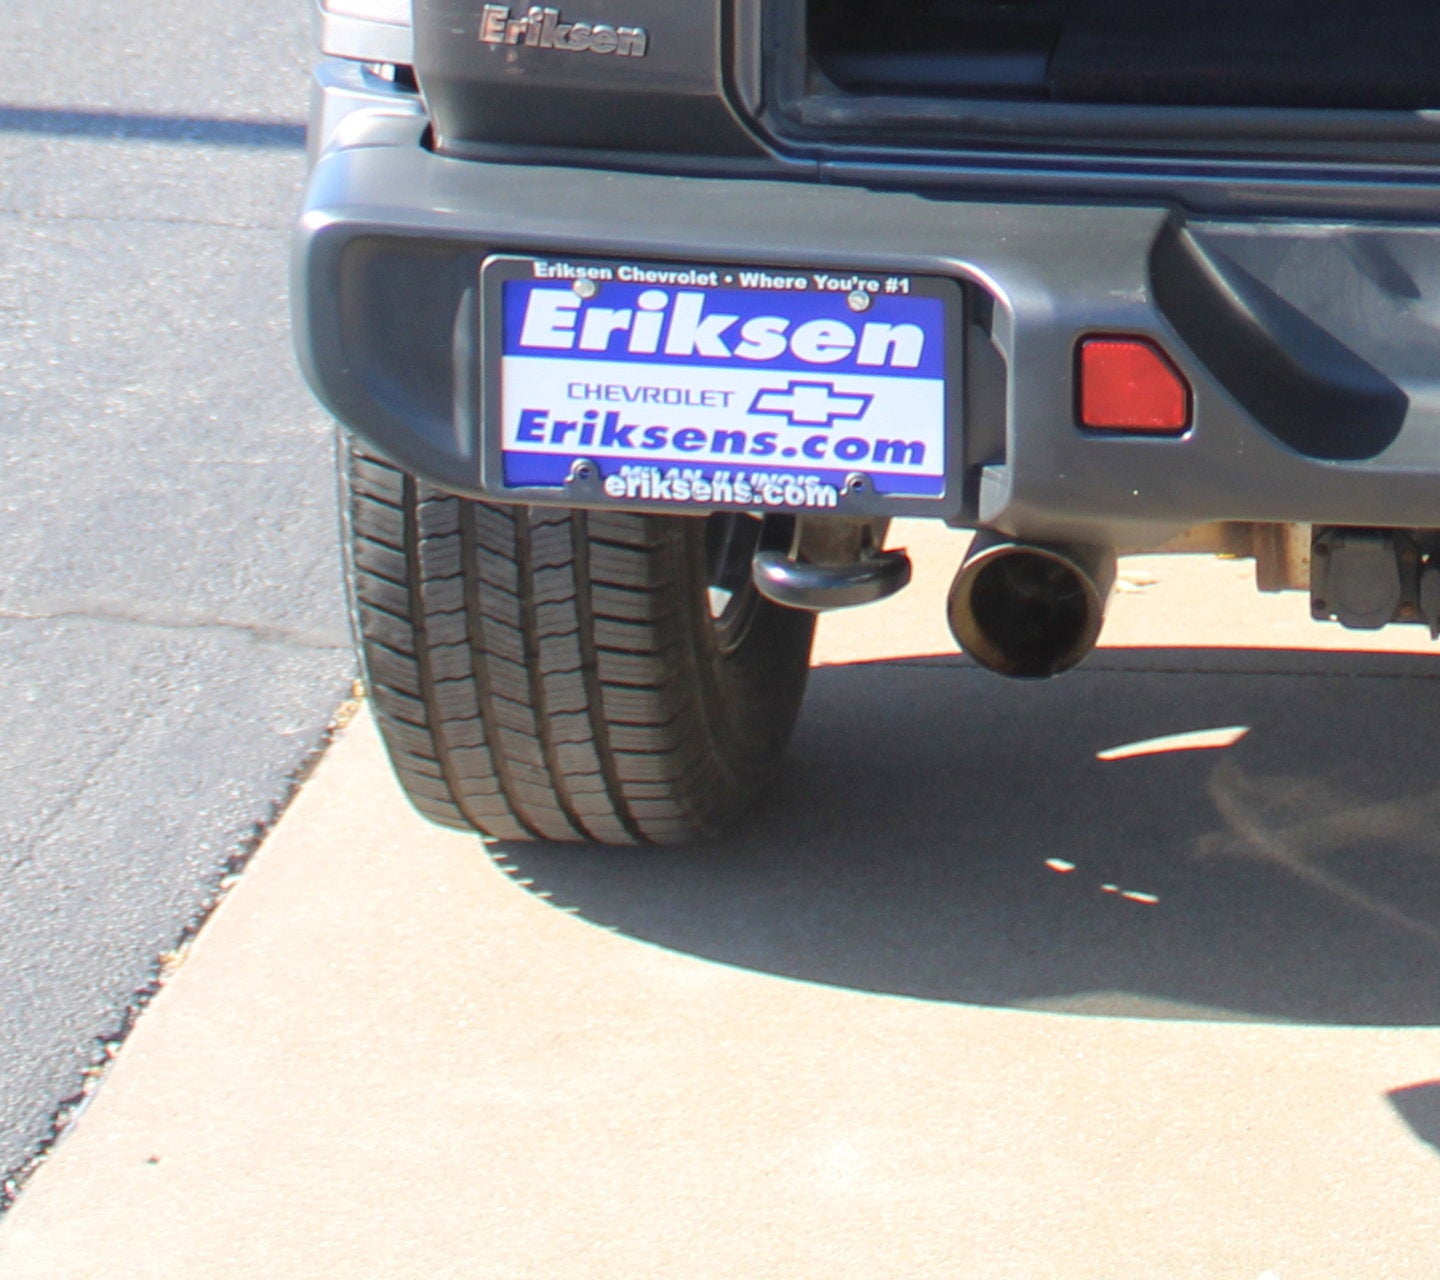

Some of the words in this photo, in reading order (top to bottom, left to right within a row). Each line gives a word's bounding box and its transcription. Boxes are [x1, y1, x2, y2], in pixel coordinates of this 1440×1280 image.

[478, 3, 649, 58] Eriksen
[533, 260, 613, 280] Eriksen
[617, 265, 720, 286] Chevrolet
[738, 272, 808, 290] Where
[813, 274, 880, 292] You're
[885, 277, 910, 294] #1
[518, 287, 926, 369] Eriksen
[566, 381, 735, 409] CHEVROLET
[515, 409, 926, 467] Eriksens.com
[604, 467, 838, 508] eriksens.com
